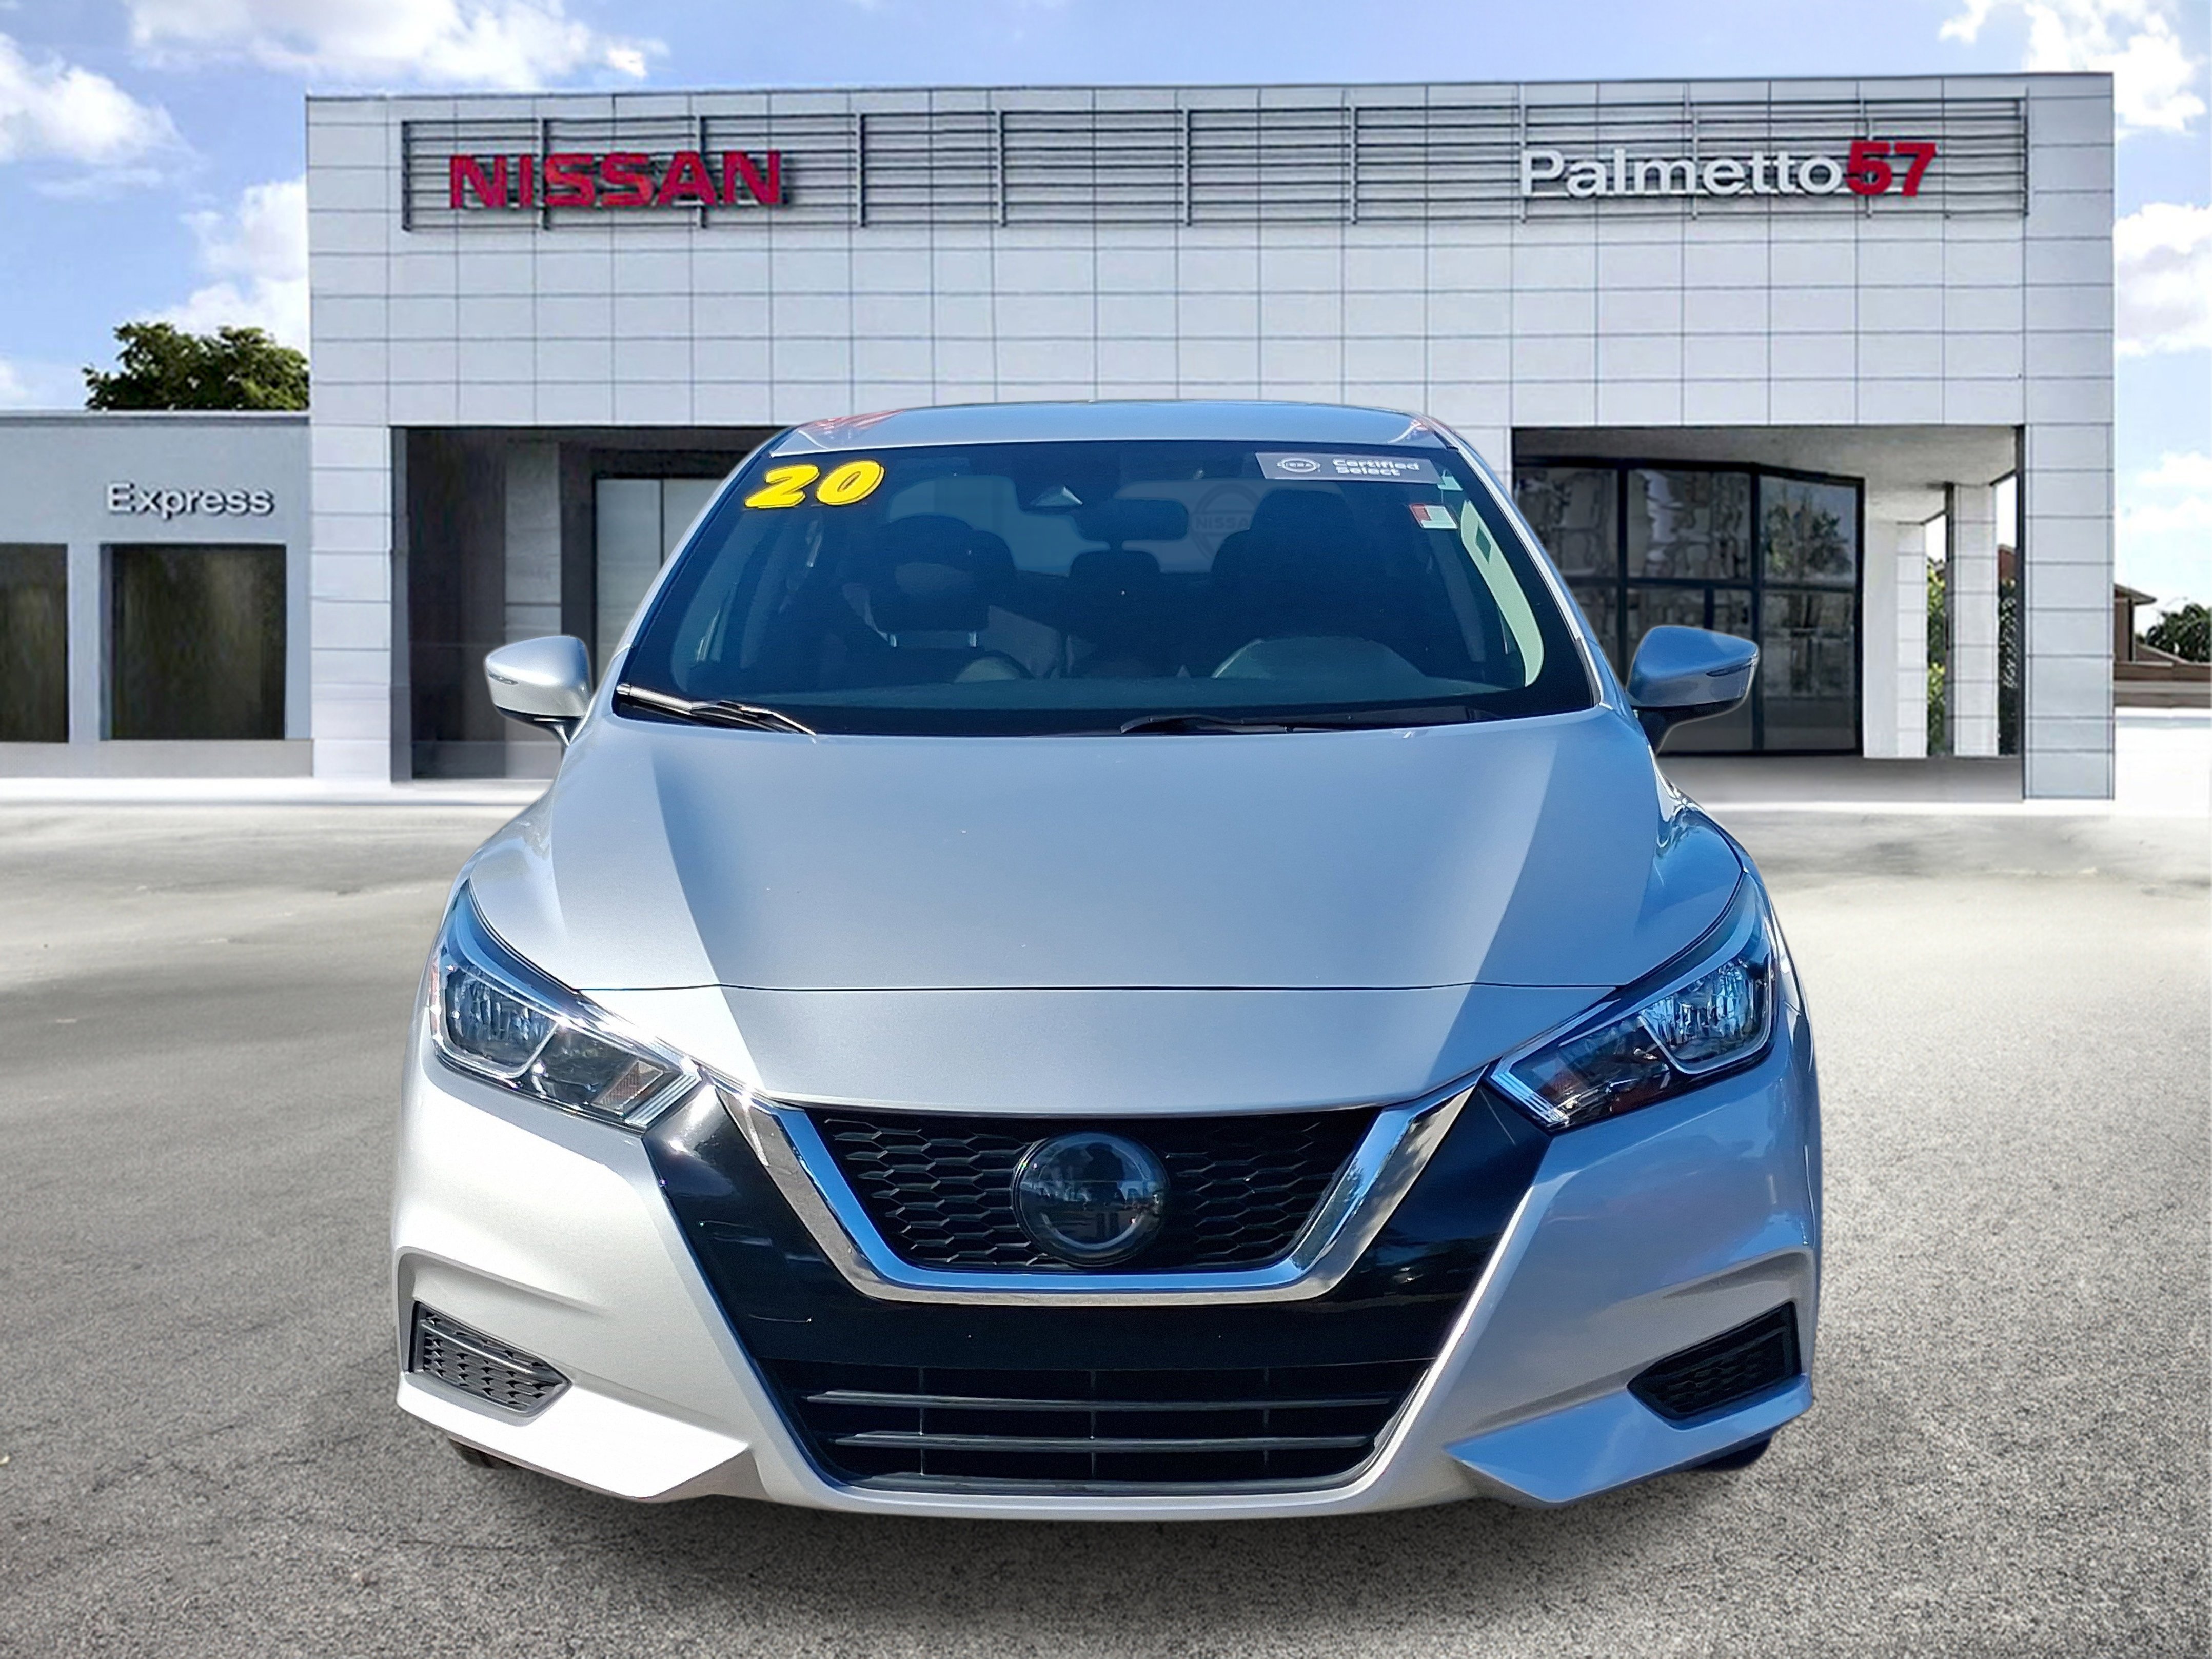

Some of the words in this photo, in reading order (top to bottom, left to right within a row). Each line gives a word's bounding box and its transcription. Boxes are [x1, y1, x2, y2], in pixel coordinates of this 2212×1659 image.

[449, 150, 782, 209] NISSAN
[1333, 459, 1420, 471] Certified
[1336, 466, 1401, 476] Select
[744, 460, 885, 509] 20
[108, 482, 274, 520] Express
[1196, 516, 1250, 530] NISSA
